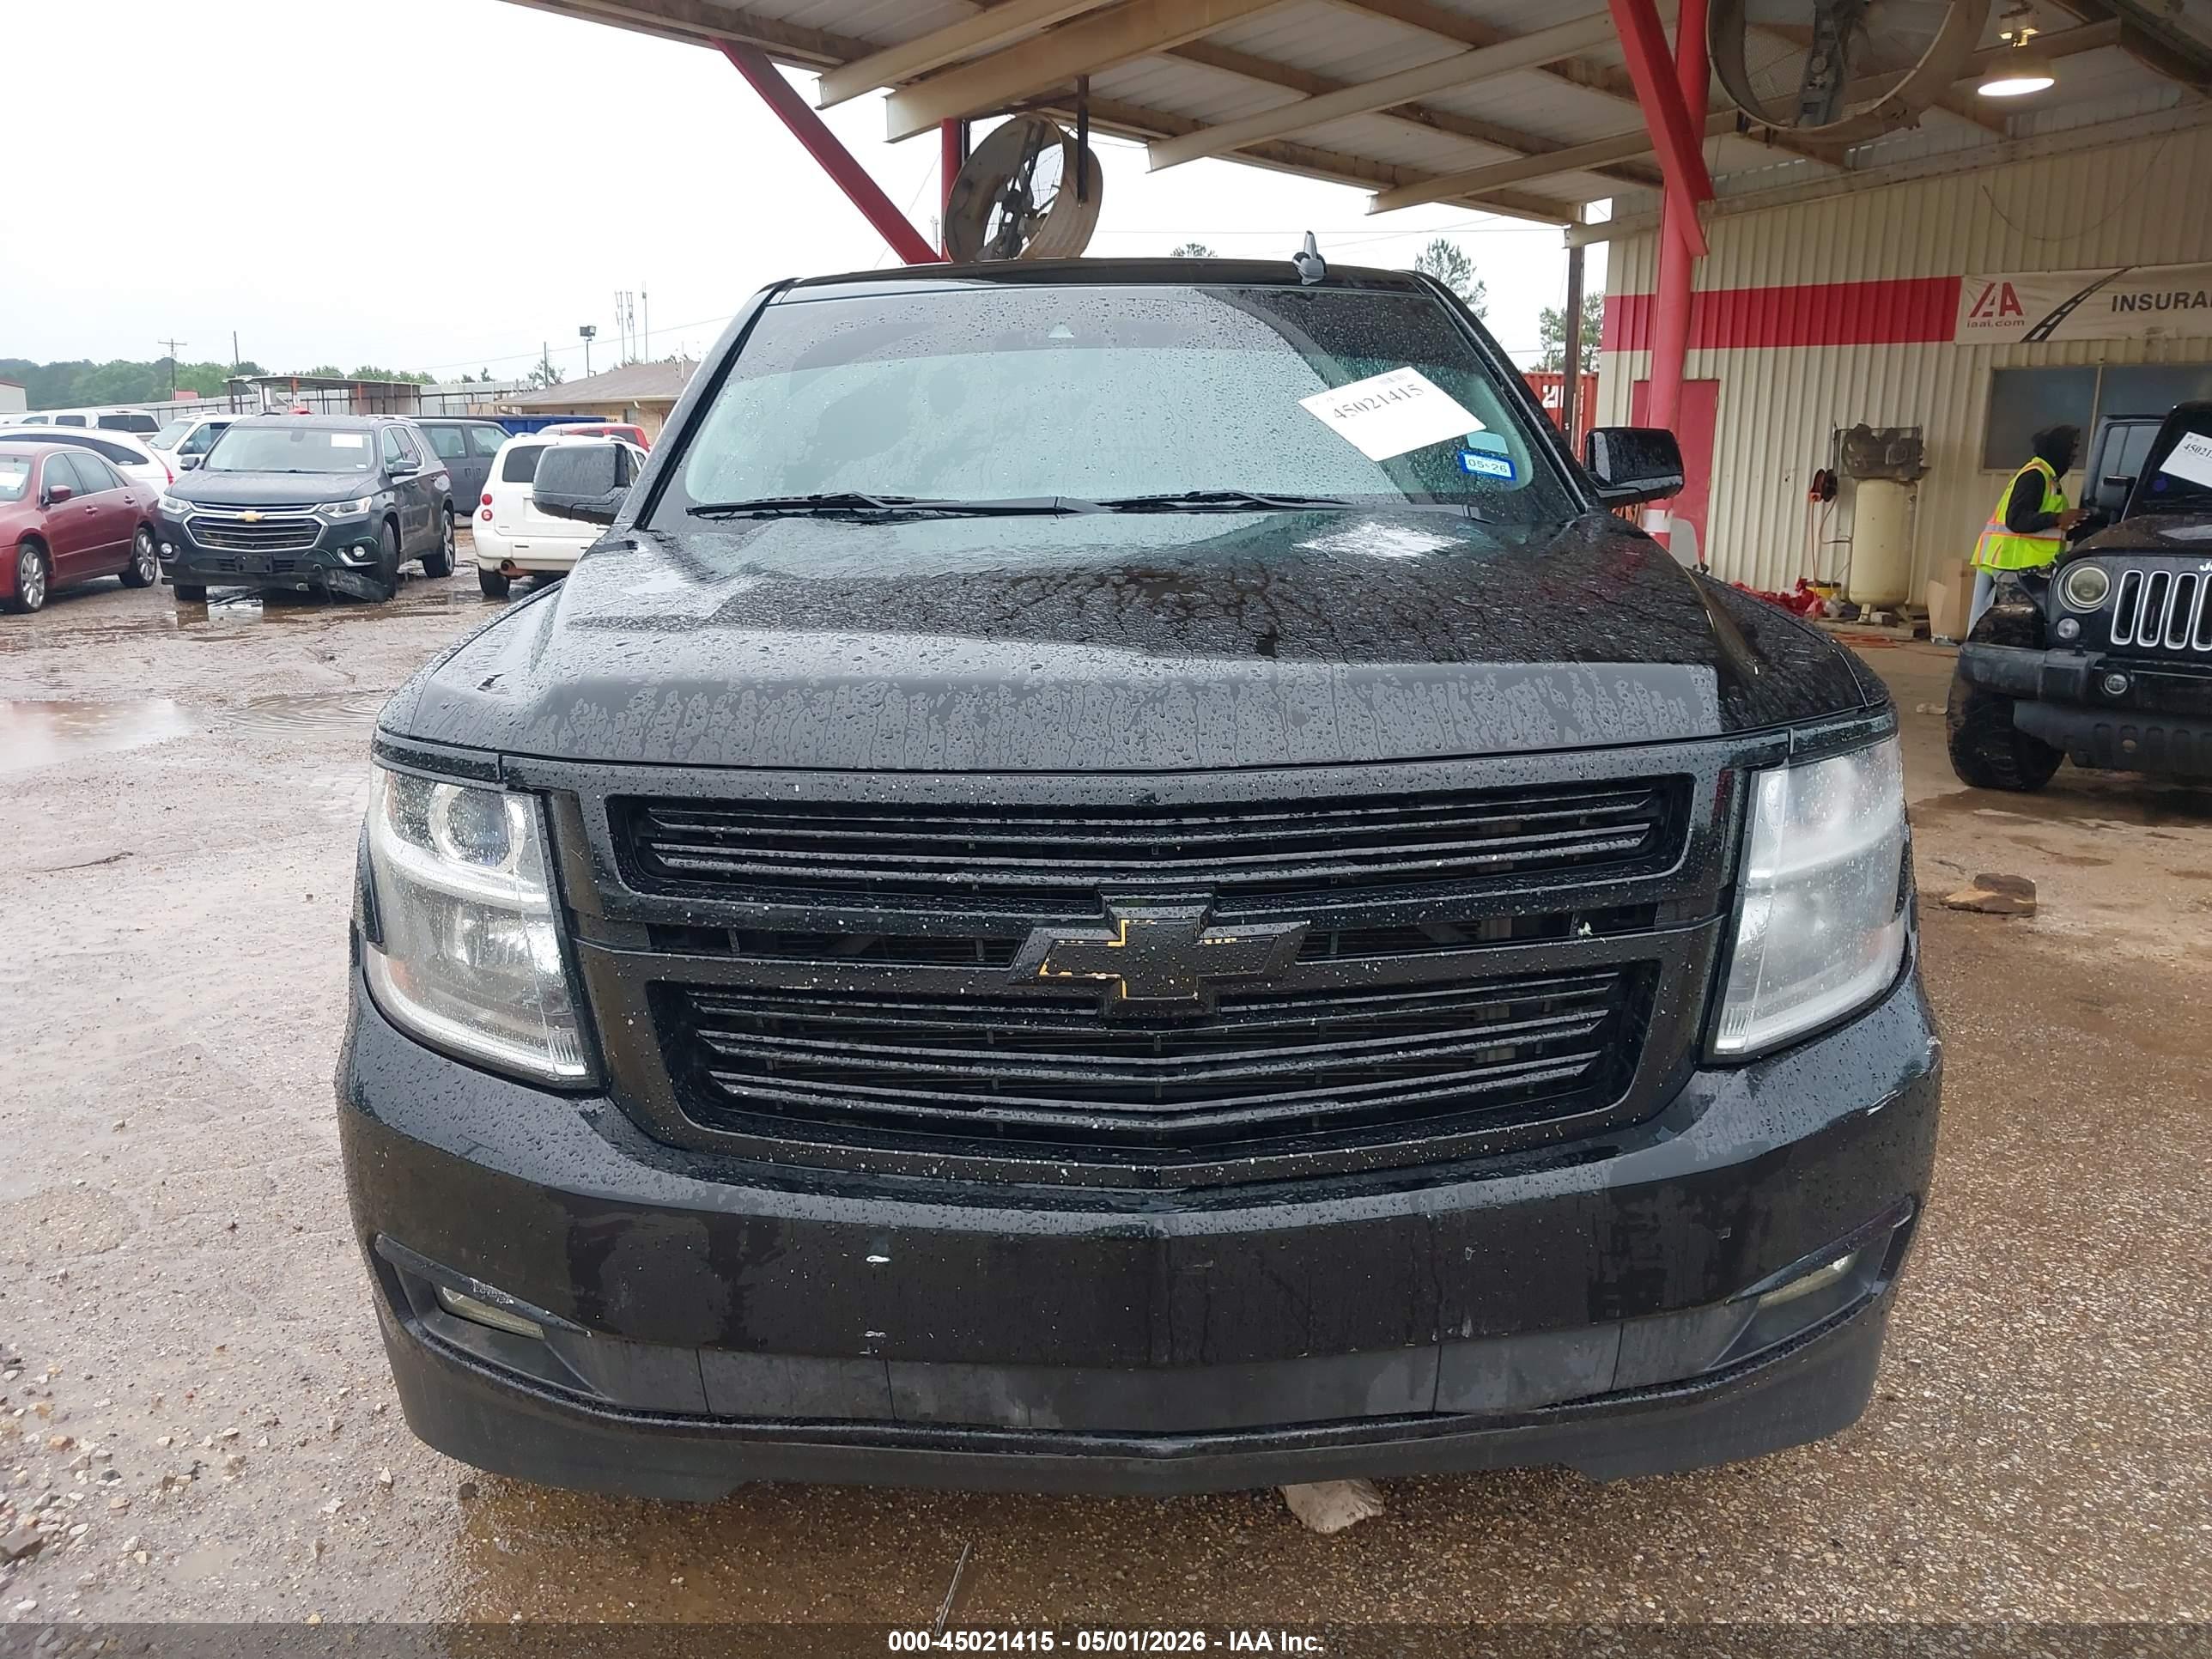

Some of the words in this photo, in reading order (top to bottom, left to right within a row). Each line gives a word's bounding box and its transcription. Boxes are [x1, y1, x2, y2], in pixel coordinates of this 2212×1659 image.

[1966, 319, 2025, 328] iaai.com
[1334, 384, 1425, 419] 45021415
[2183, 442, 2212, 459] 45021
